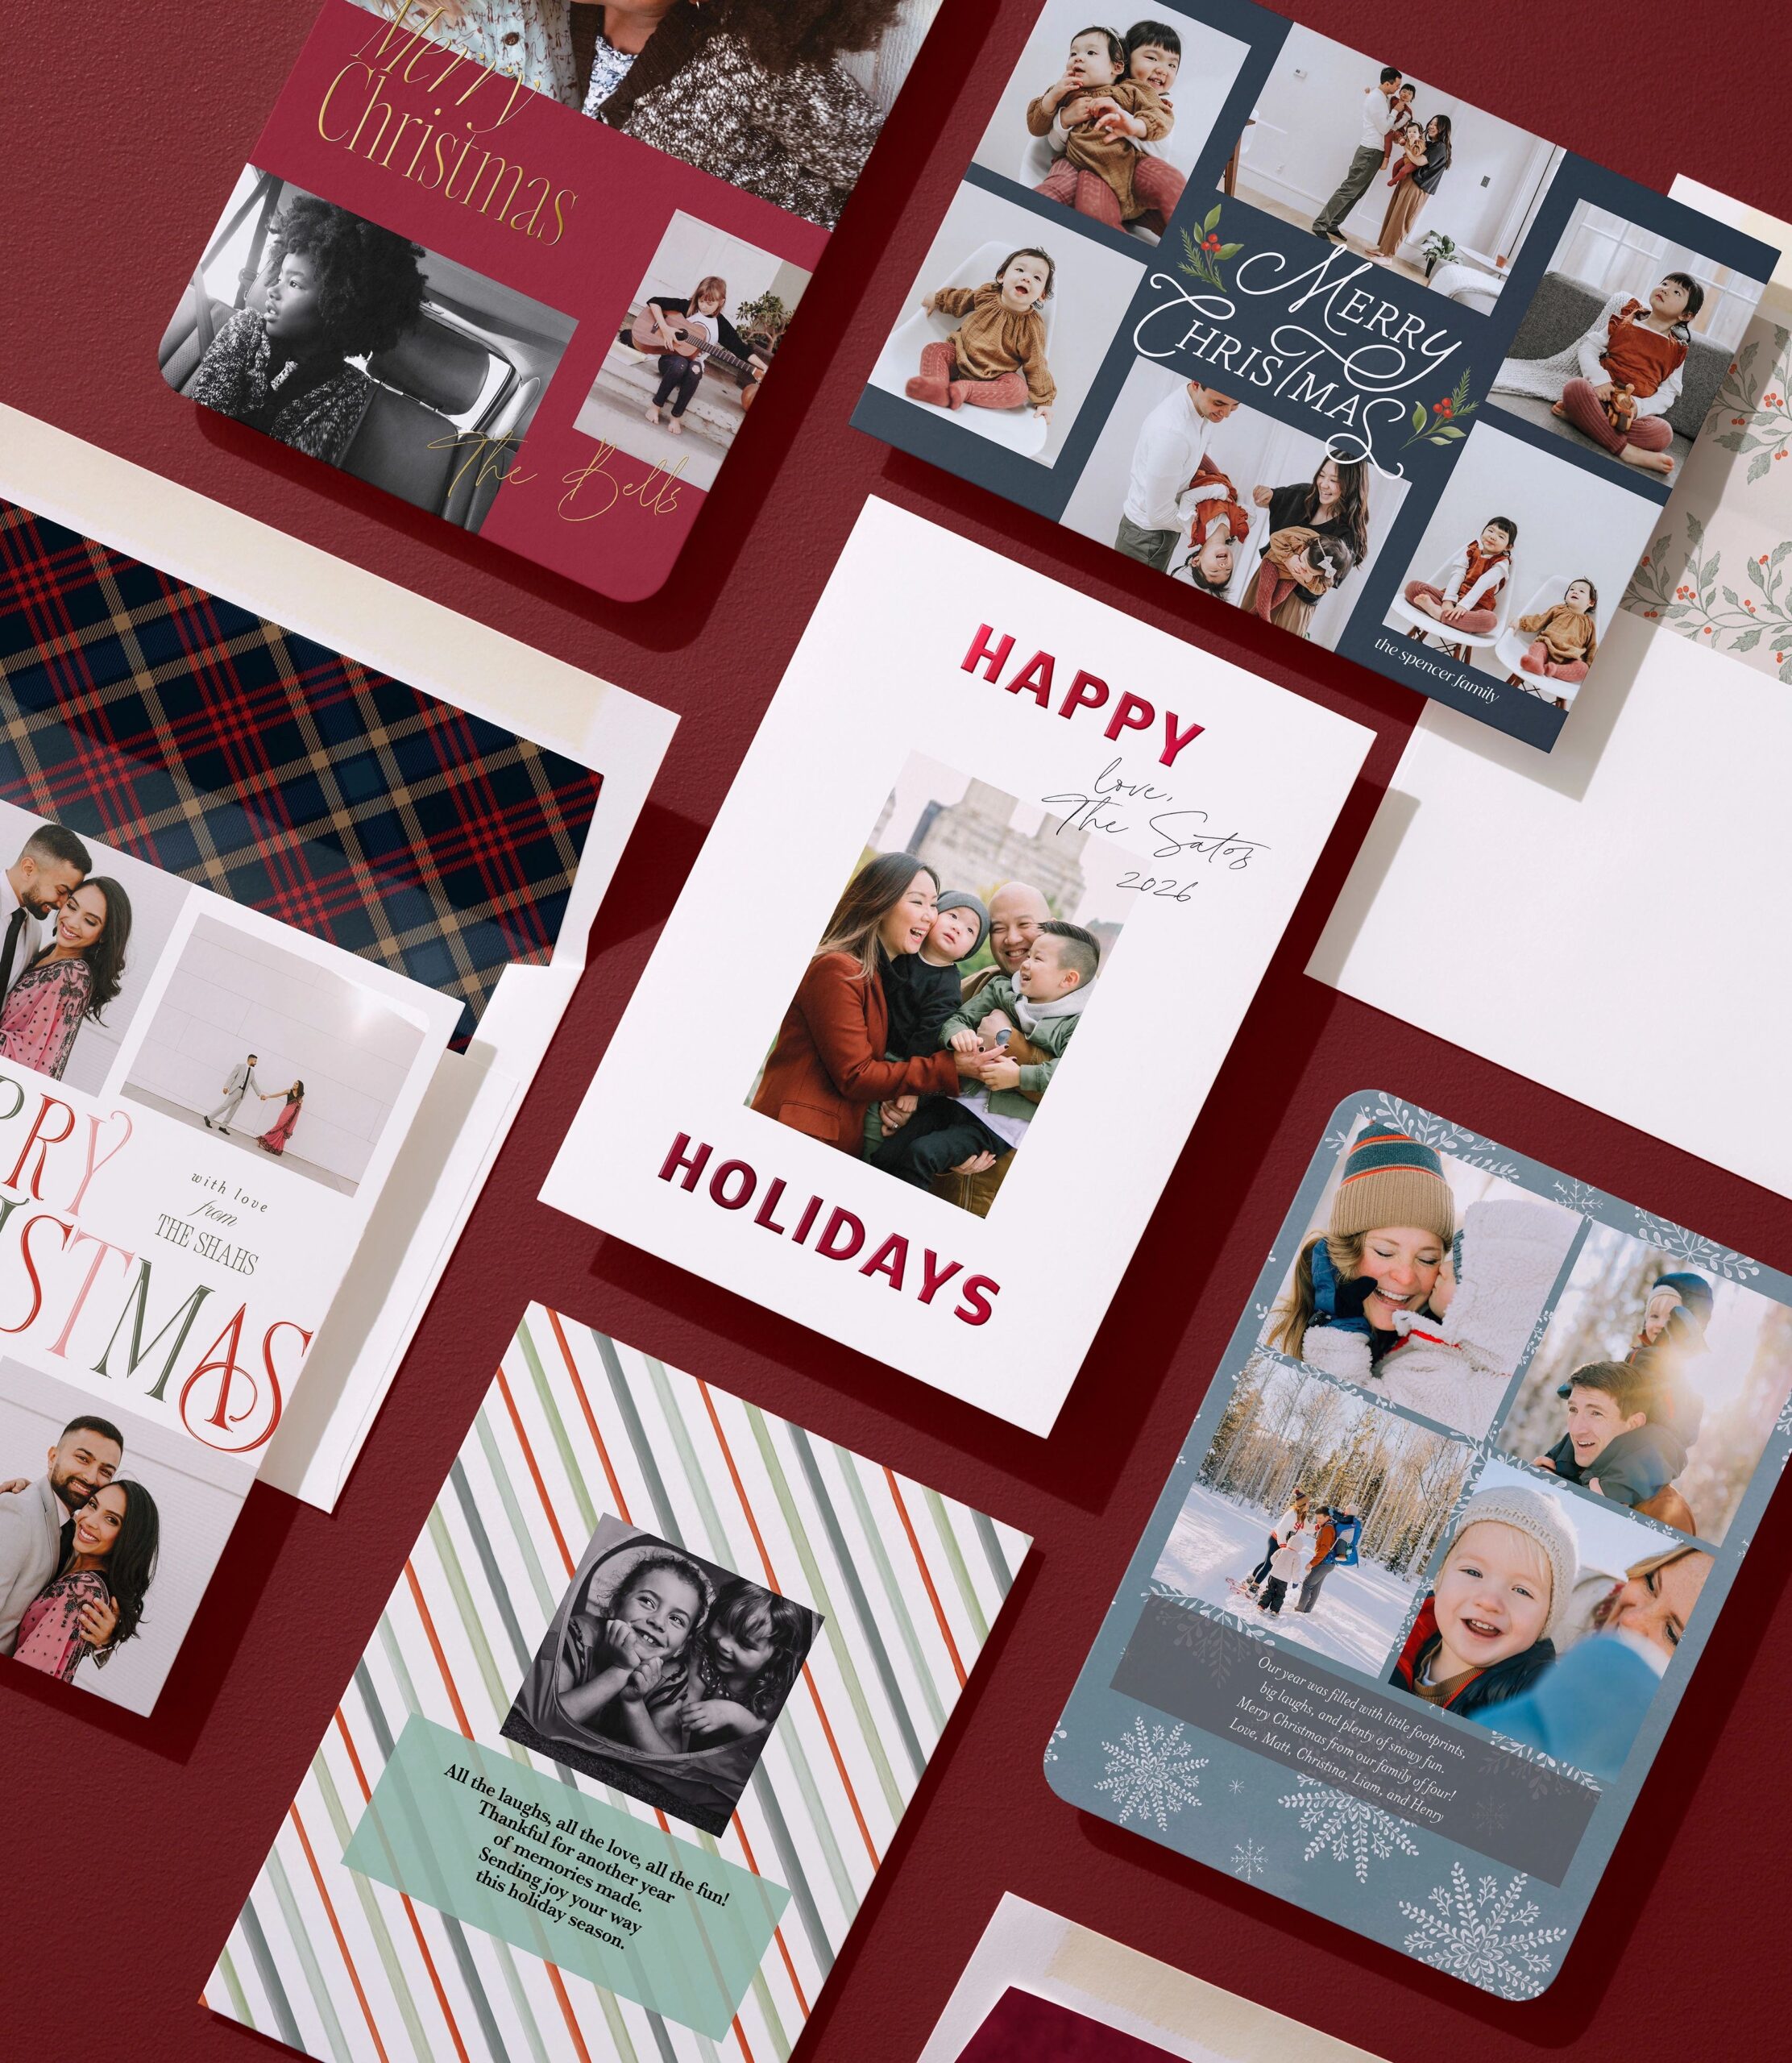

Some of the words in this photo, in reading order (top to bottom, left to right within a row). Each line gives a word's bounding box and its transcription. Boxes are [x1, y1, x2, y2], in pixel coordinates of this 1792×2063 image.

[350, 0, 540, 134] Merry
[318, 62, 579, 246] Christmas
[1133, 273, 1405, 480] CHRISTMAS
[427, 431, 538, 498] The
[558, 438, 688, 521] Bells
[960, 623, 1205, 767] HAPPY
[1375, 638, 1398, 656] the
[1399, 650, 1455, 681] spencer
[1451, 675, 1500, 704] family
[1041, 794, 1129, 836] The
[1094, 758, 1173, 802] love,
[1117, 872, 1198, 902] 2026
[187, 1200, 238, 1227] from
[192, 1173, 226, 1194] with
[234, 1188, 268, 1212] love
[657, 1131, 1001, 1326] HOLIDAYS
[155, 1214, 194, 1247] THE
[193, 1232, 259, 1276] SHAHS
[1236, 1696, 1271, 1721] Merry
[1273, 1712, 1327, 1745] Christmas
[1323, 1737, 1354, 1758] from
[1356, 1754, 1376, 1766] our
[1373, 1759, 1411, 1784] family
[1413, 1778, 1429, 1791] of
[1422, 1781, 1457, 1801] four!
[1259, 1657, 1281, 1674] Our
[1275, 1670, 1306, 1685] year
[1308, 1681, 1328, 1696] was
[1325, 1688, 1359, 1708] filled
[1359, 1704, 1383, 1721] with
[1384, 1712, 1411, 1732] little
[1408, 1725, 1465, 1759] footprints,
[1260, 1682, 1277, 1701] big
[1278, 1690, 1314, 1716] laughs,
[1318, 1712, 1342, 1725] and
[1338, 1721, 1374, 1743] plenty
[1376, 1737, 1392, 1750] of
[1388, 1743, 1422, 1764] snowy
[1419, 1755, 1444, 1773] fun.
[1230, 1717, 1257, 1741] Love,
[1262, 1732, 1291, 1755] Matt,
[1296, 1747, 1348, 1782] Christina,
[1352, 1772, 1383, 1796] Liam,
[1387, 1791, 1410, 1806] and
[1410, 1798, 1444, 1823] Henry
[443, 1763, 467, 1784] All
[471, 1773, 495, 1797] the
[498, 1787, 551, 1827] laughs,
[556, 1817, 577, 1836] all
[580, 1827, 604, 1849] the
[608, 1838, 641, 1869] love,
[645, 1862, 667, 1878] all
[670, 1870, 694, 1891] the
[699, 1882, 729, 1907] fun!
[479, 1799, 550, 1849] Thankful
[550, 1834, 575, 1856] for
[577, 1850, 638, 1888] another
[641, 1880, 675, 1904] year
[493, 1834, 515, 1847] of
[513, 1844, 593, 1888] memories
[595, 1883, 642, 1913] made.
[475, 1870, 504, 1894] this
[508, 1880, 566, 1924] holiday
[568, 1916, 624, 1949] season.
[479, 1846, 542, 1887] Sending
[541, 1878, 569, 1901] joy
[569, 1895, 608, 1917] your
[611, 1911, 642, 1936] way
